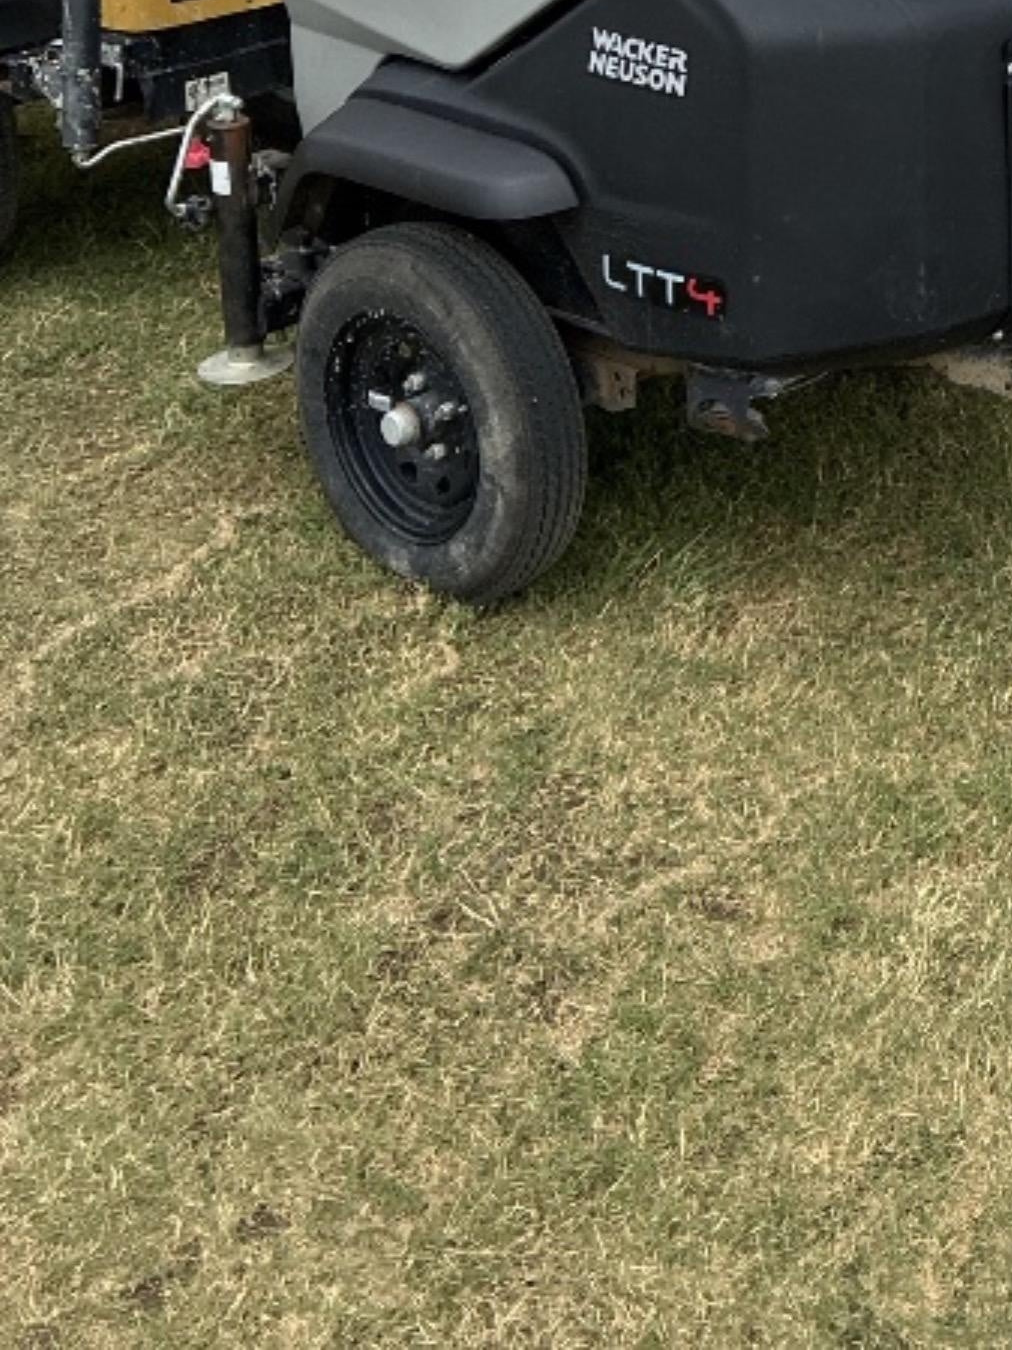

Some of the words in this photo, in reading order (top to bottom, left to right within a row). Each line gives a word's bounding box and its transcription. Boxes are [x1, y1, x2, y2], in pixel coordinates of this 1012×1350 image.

[592, 26, 688, 72] WACKER
[588, 50, 687, 97] NEUSON
[602, 253, 722, 316] LTT4
